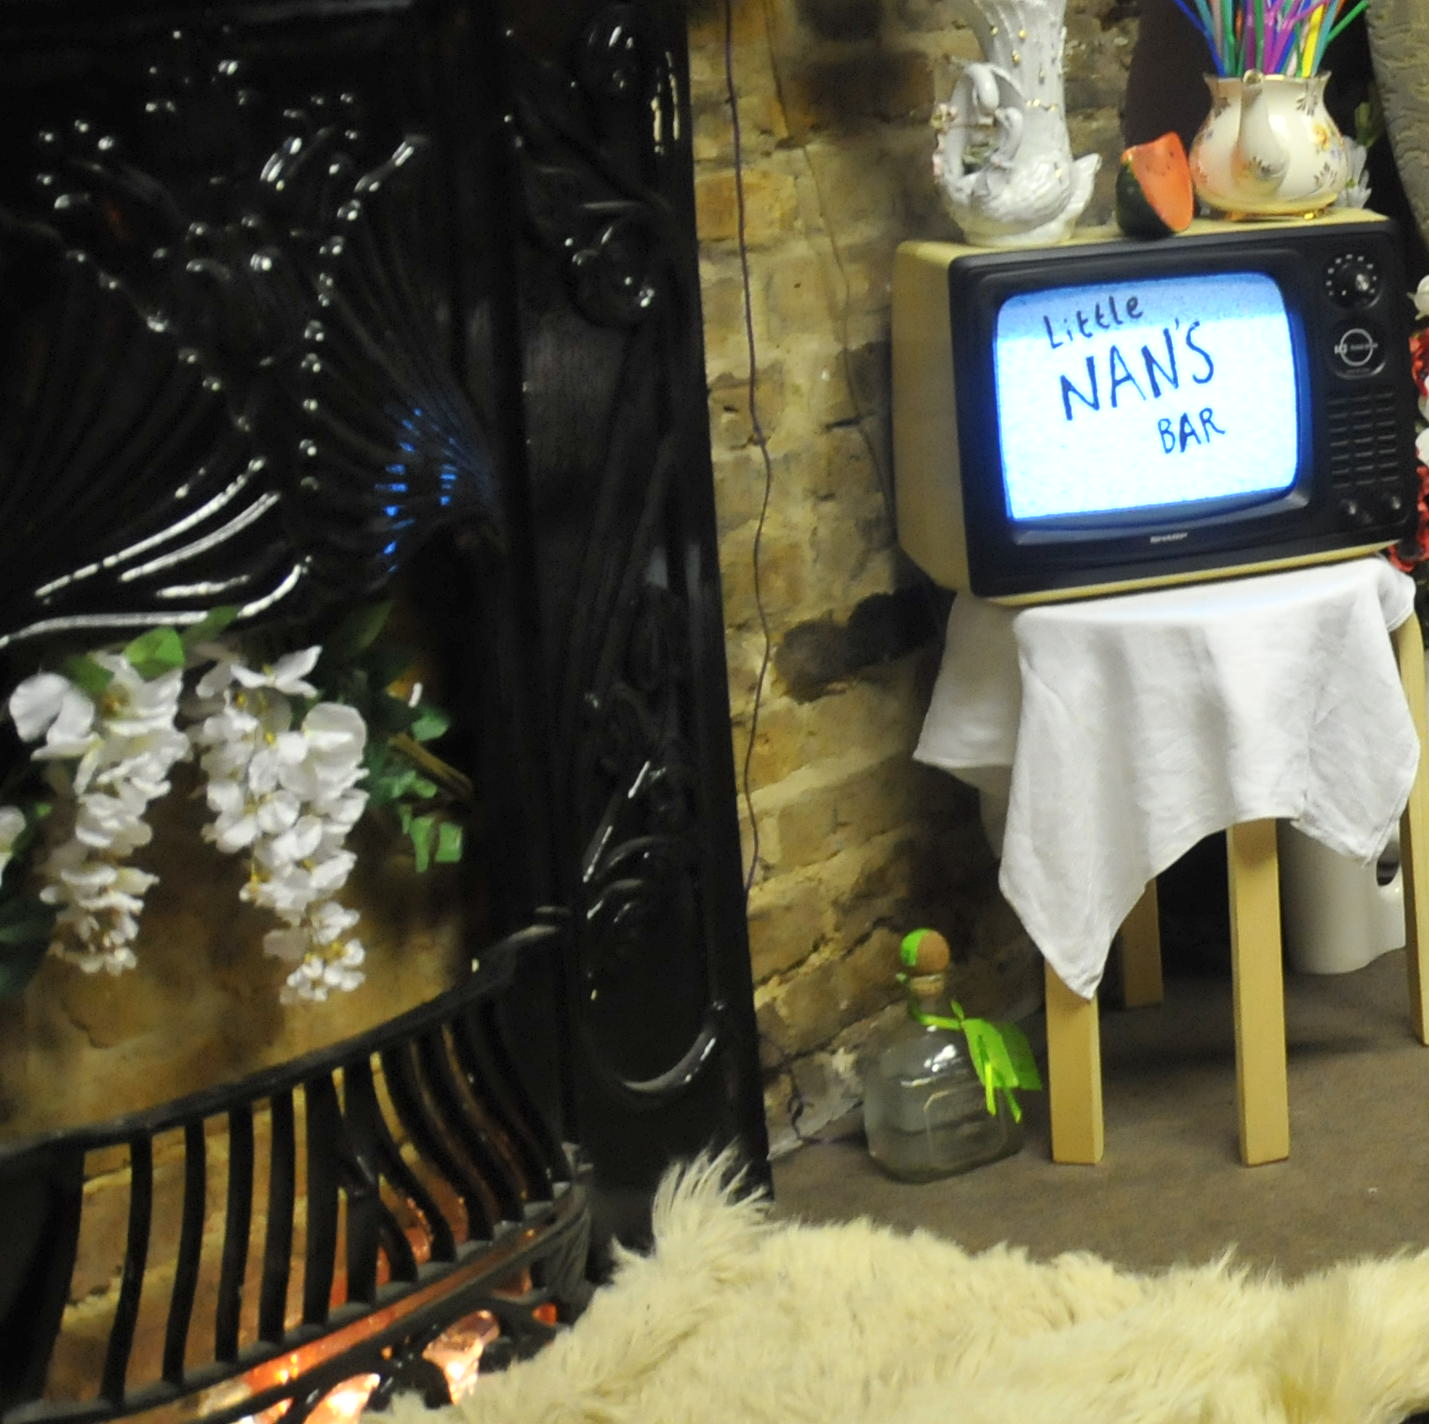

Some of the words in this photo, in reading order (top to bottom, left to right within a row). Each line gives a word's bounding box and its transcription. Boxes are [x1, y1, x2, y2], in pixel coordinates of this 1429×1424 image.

[1043, 295, 1143, 349] Little
[1060, 318, 1214, 421] NAN'S
[1157, 407, 1226, 454] BAR
